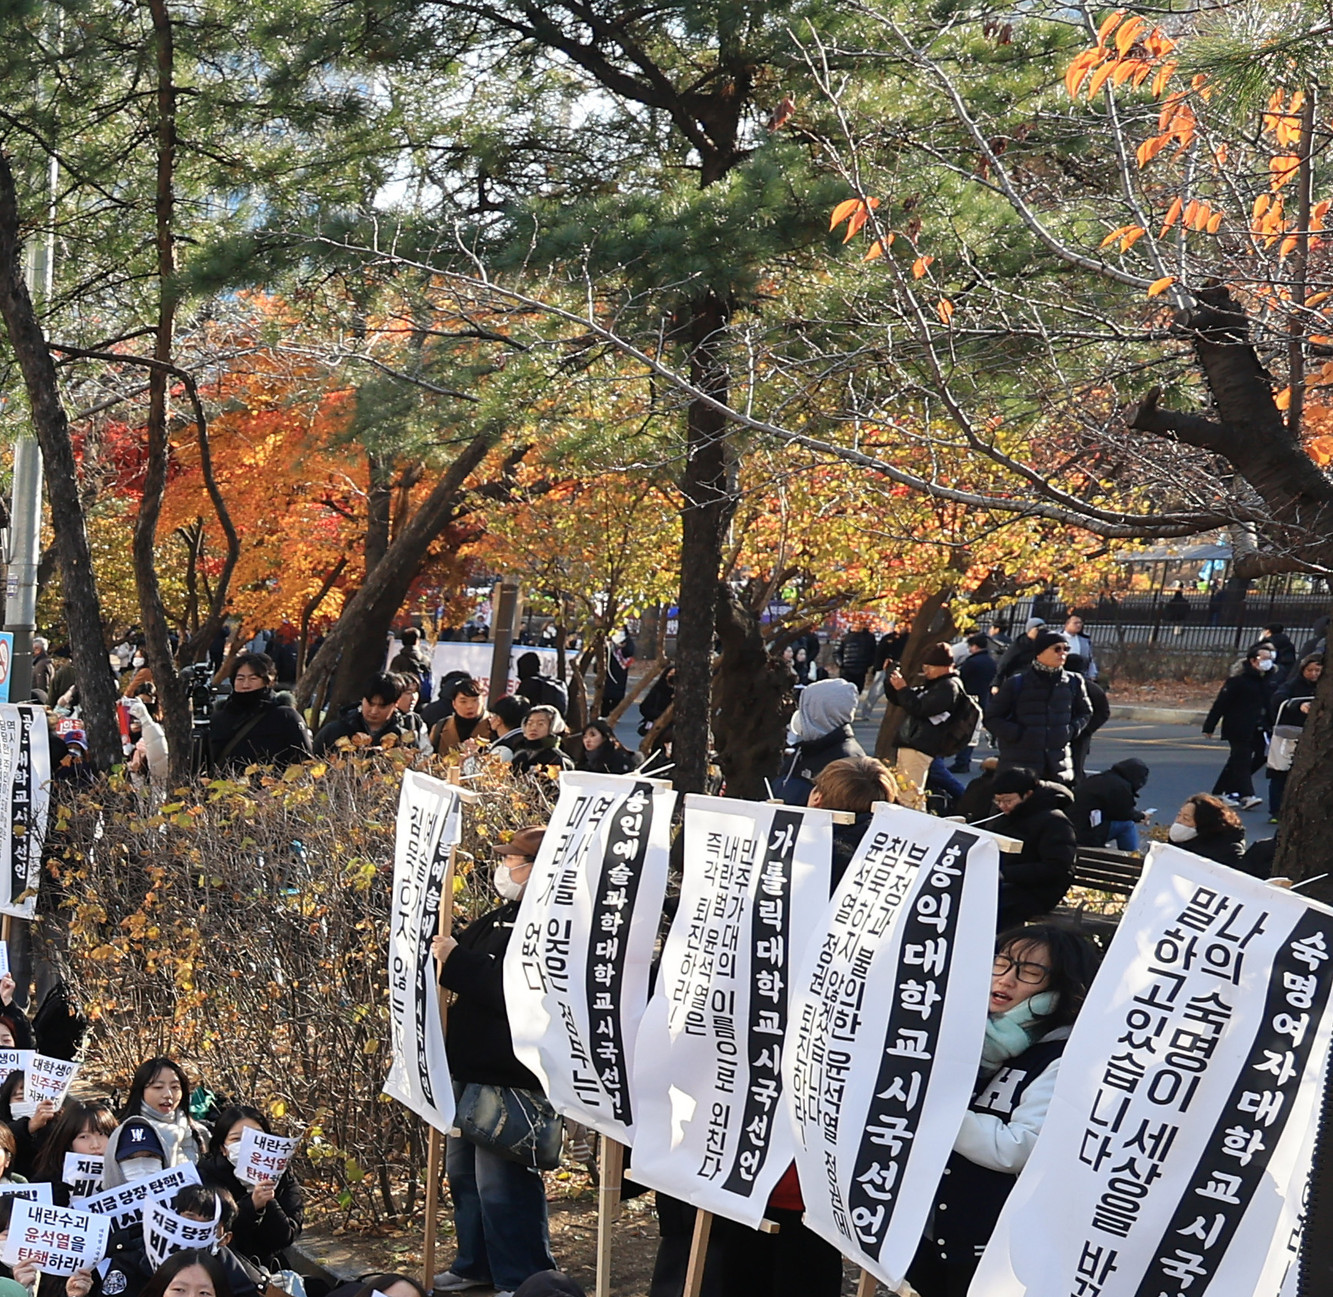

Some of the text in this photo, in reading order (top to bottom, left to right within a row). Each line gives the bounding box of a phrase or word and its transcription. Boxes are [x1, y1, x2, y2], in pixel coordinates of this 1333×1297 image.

[522, 796, 587, 994] 미래가 없다
[546, 796, 615, 1107] 역사를 잊은 정부는
[592, 790, 649, 1011] 용인예술과학대학교
[668, 832, 722, 1031] 즉각 퇴진하라!
[686, 835, 741, 1038] 내란범 윤석열은
[867, 841, 930, 939] 부정과
[1200, 901, 1269, 987] 나의
[710, 990, 738, 1095] 이름으로
[739, 824, 794, 1182] 가톨릭대학교 시국선언
[793, 831, 889, 1153] 윤석열 정권 퇴진하라!
[806, 834, 905, 1127] 침묵하지 않겠습니다
[830, 944, 875, 1044] 불의한
[850, 843, 962, 1244] 홍익대학교 시국선언
[1146, 990, 1233, 1115] 숙명이
[697, 1101, 731, 1181] 외친다
[822, 1050, 852, 1146] 윤석열
[974, 1066, 1029, 1113] H
[1195, 929, 1331, 1205] 숙명여자대학교
[27, 1206, 90, 1232] 내란수괴
[1091, 1118, 1179, 1239] 세상을
